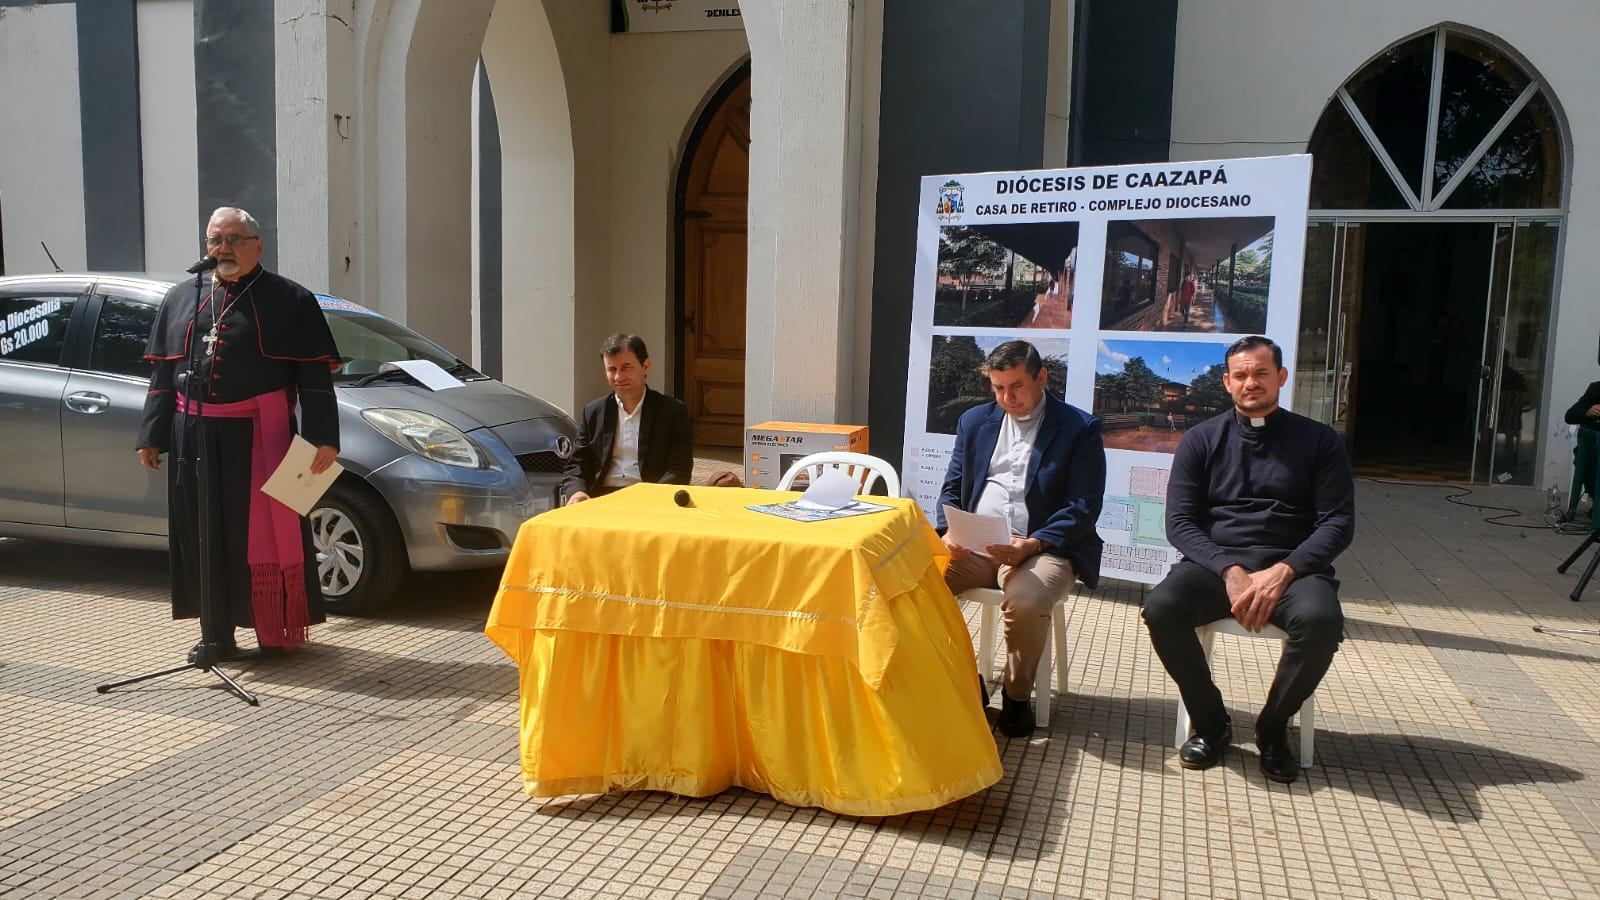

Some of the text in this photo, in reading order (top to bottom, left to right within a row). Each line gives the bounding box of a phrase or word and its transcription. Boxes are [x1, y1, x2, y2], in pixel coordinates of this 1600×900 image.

[996, 164, 1228, 195] DIÓCESIS DE CAAZAPÁ
[975, 204, 1007, 216] CASA
[1011, 203, 1027, 214] DE
[1030, 201, 1077, 213] RETIRO
[1088, 198, 1161, 211] COMPLEJO
[1166, 194, 1251, 208] DIOCESANO
[7, 298, 62, 331] Diocesana
[0, 319, 49, 356] Gs 20.000
